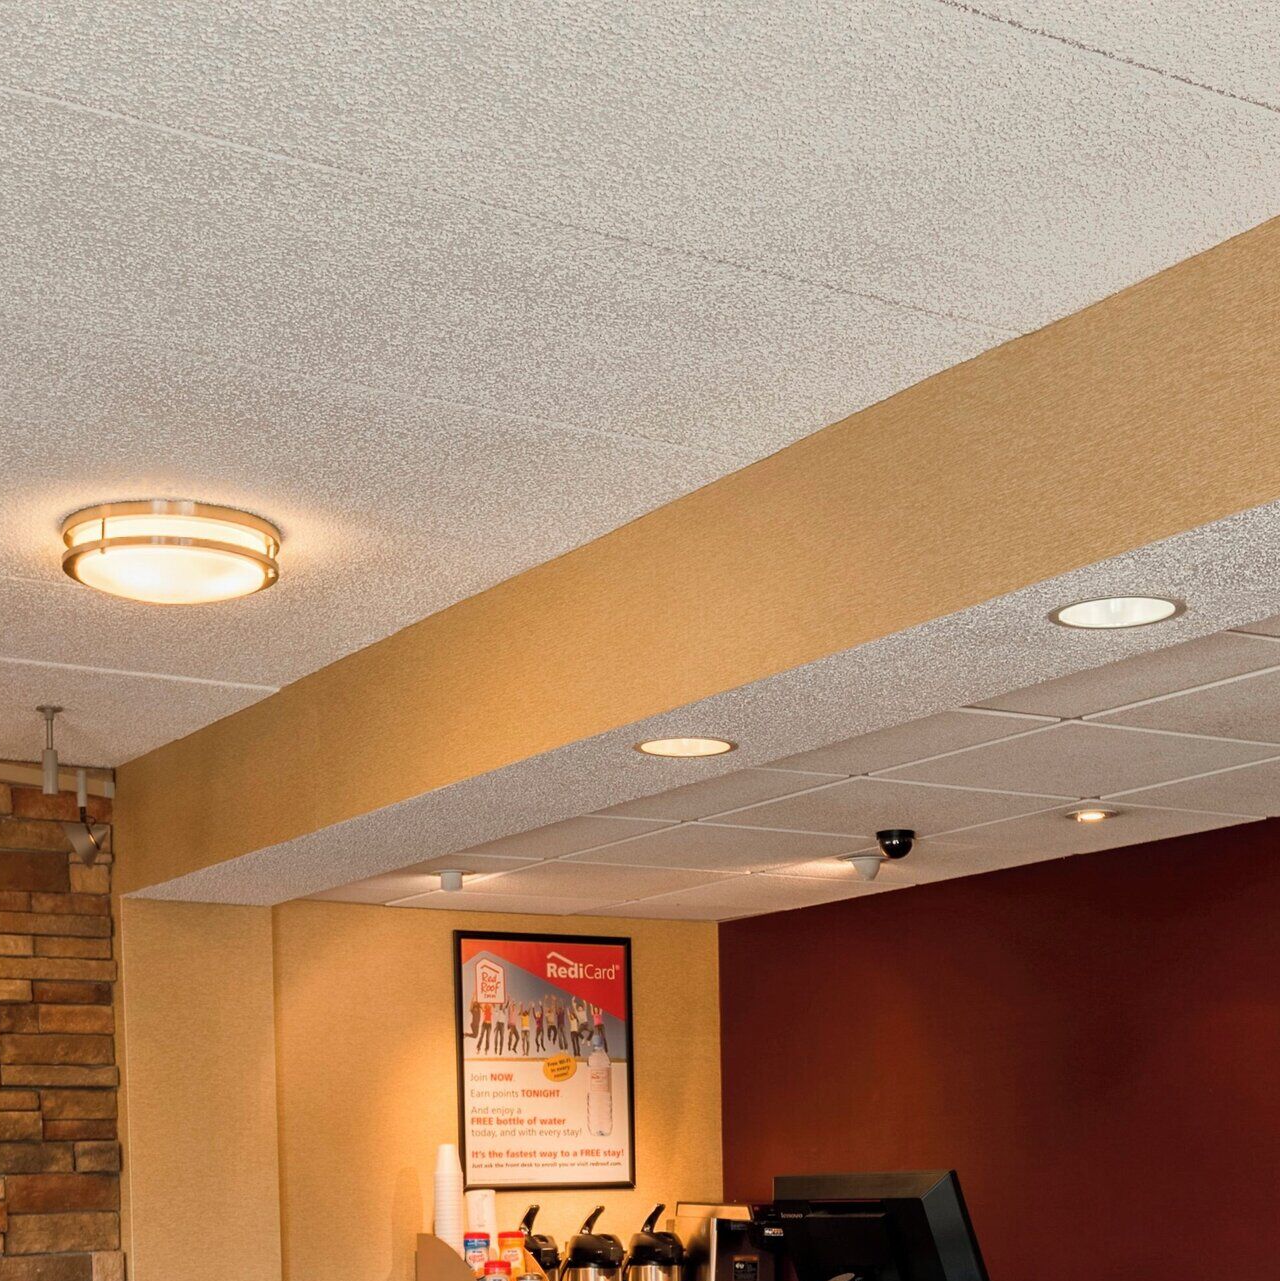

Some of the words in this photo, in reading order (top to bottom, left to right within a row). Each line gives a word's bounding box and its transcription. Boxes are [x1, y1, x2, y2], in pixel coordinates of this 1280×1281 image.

[481, 971, 497, 982] Red
[481, 981, 501, 993] Roof
[470, 1073, 488, 1081] Join
[470, 1089, 490, 1098] Earn
[492, 1089, 519, 1100] points
[471, 1106, 489, 1114] And
[491, 1106, 515, 1116] enjoy
[471, 1117, 494, 1125] FREE
[496, 1117, 524, 1125] bottle
[527, 1117, 537, 1125] of
[471, 1129, 498, 1138] today,
[518, 1128, 537, 1136] with
[539, 1130, 561, 1138] every
[562, 1128, 582, 1138] stay!
[472, 1150, 485, 1158] It's
[488, 1150, 503, 1158] the
[506, 1150, 537, 1158] fastest
[540, 1151, 557, 1159] way
[580, 1149, 601, 1157] FREE
[603, 1149, 624, 1159] stay!
[780, 1211, 803, 1219] lenovo
